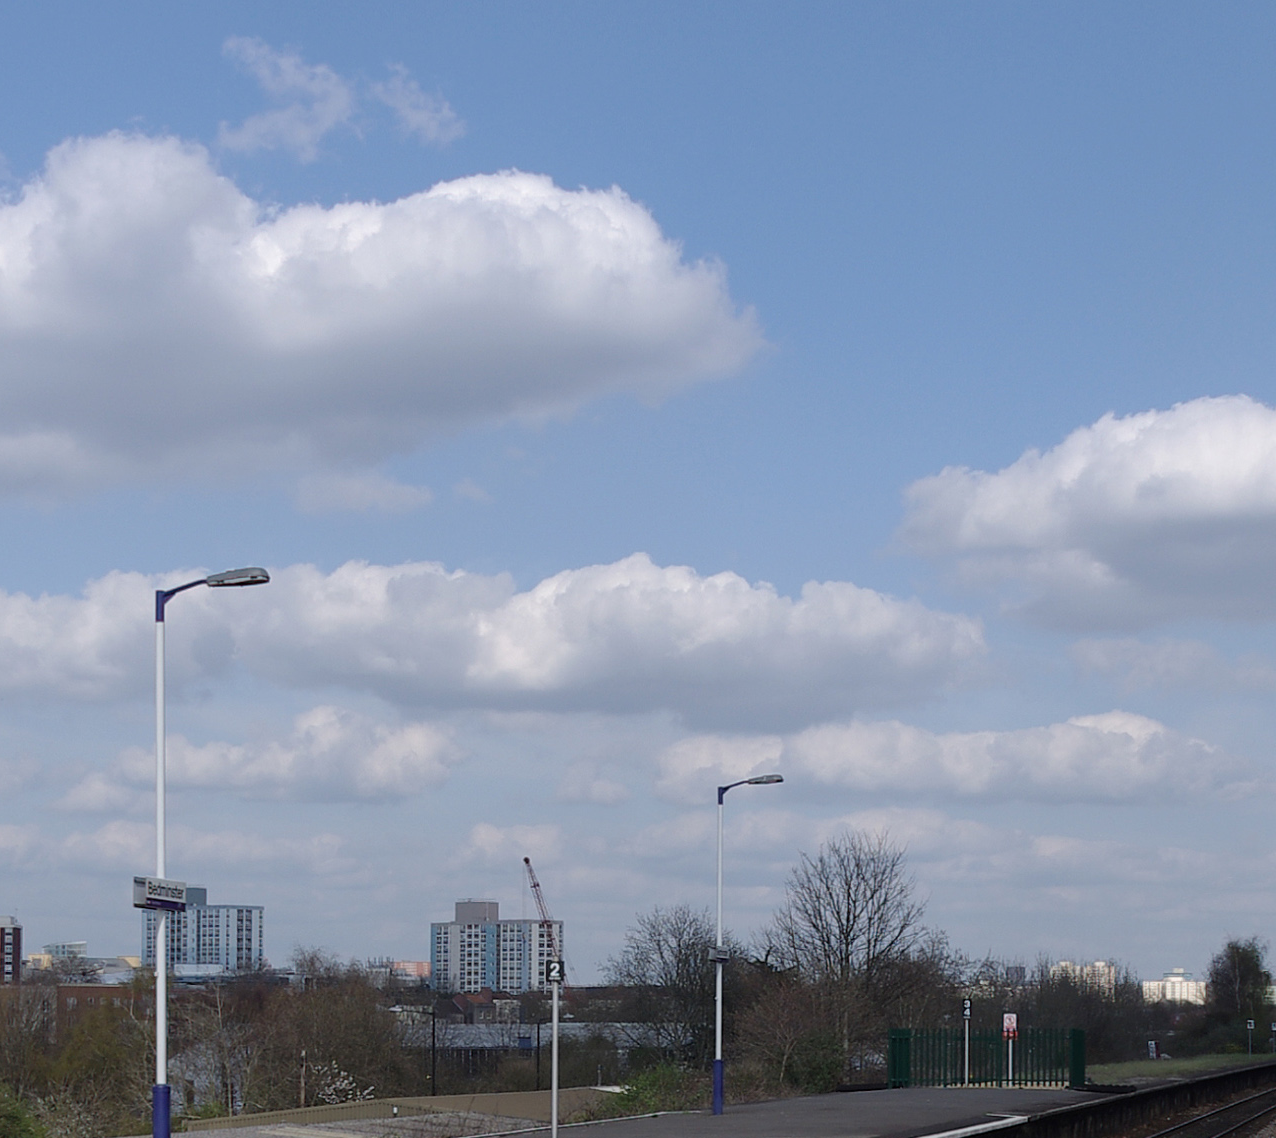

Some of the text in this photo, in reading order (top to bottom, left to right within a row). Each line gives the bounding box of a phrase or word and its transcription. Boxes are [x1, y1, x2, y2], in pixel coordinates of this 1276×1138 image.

[148, 881, 184, 899] Bedminster
[550, 962, 560, 976] 2
[964, 1000, 971, 1008] 3
[964, 1008, 971, 1016] 4
